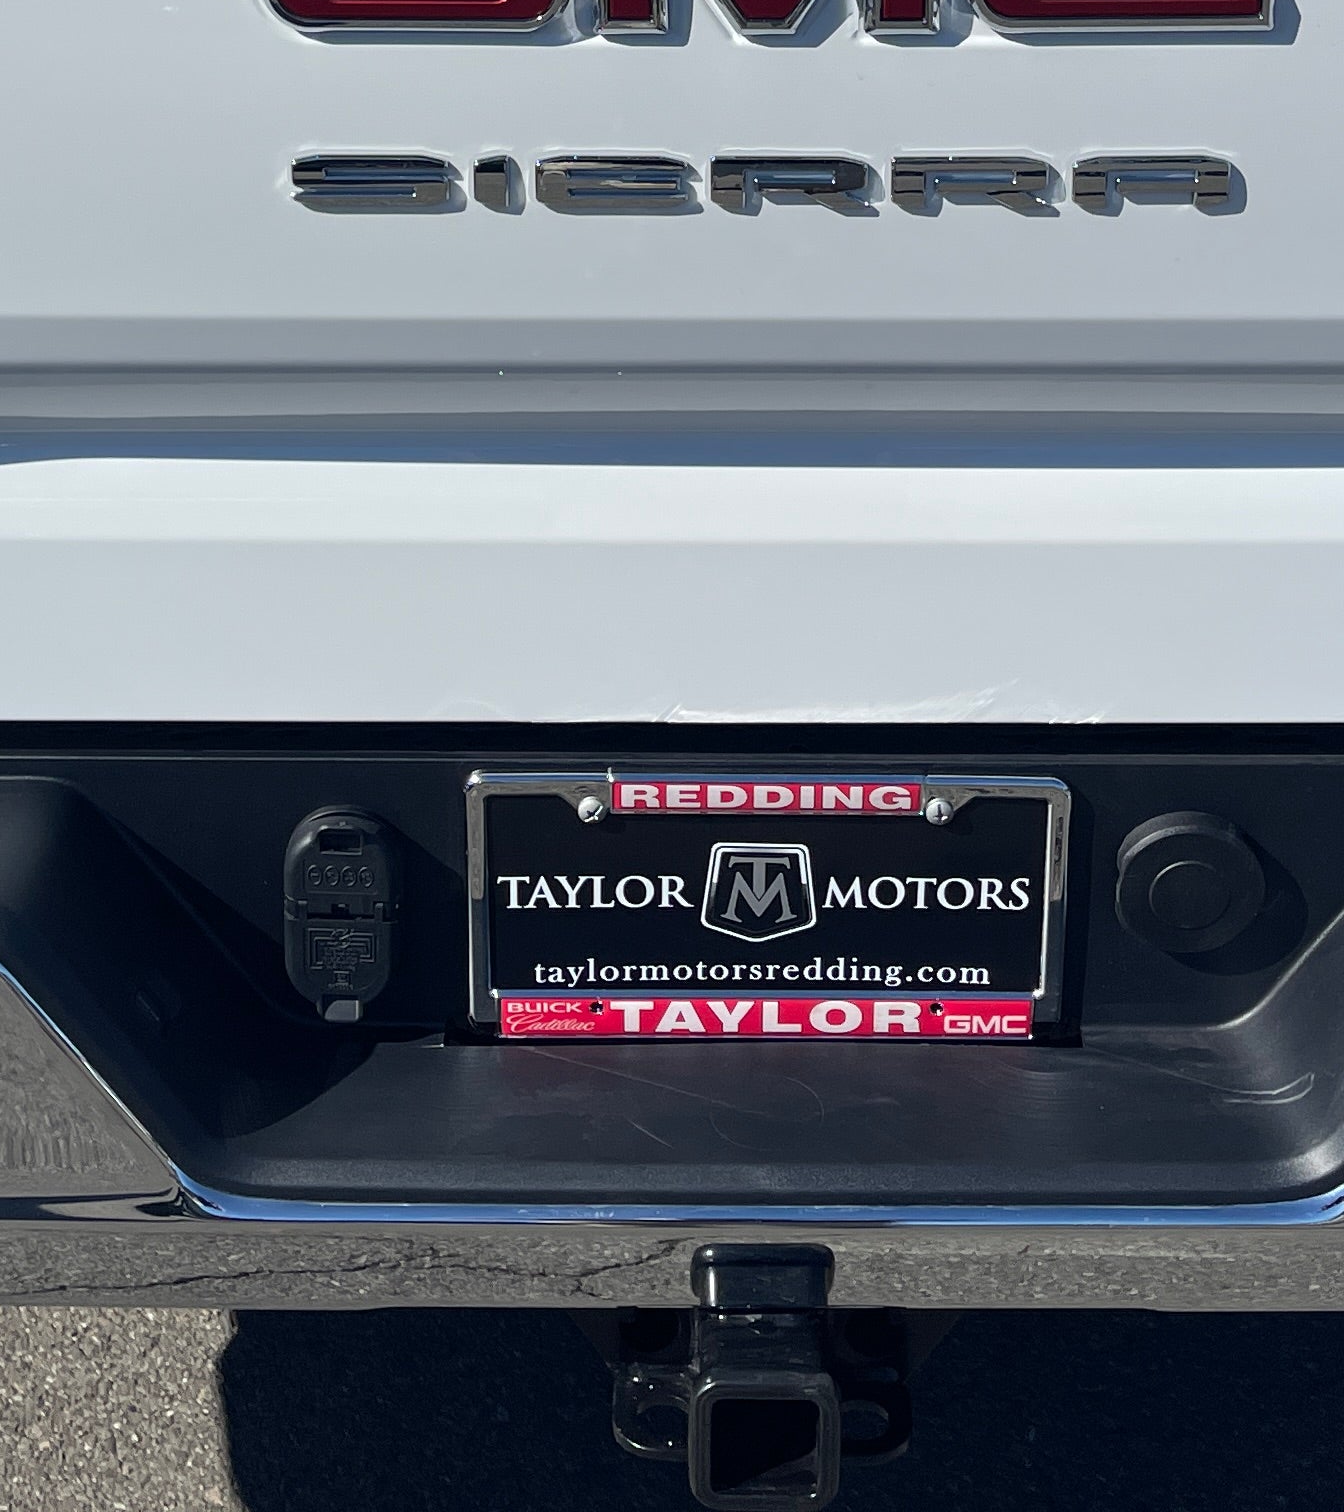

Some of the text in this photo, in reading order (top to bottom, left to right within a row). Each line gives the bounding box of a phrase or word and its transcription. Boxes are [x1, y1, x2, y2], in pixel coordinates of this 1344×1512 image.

[290, 153, 1240, 213] SIERRA
[620, 783, 912, 811] REDDING
[496, 874, 1031, 911] TAYLOR MOTORS
[533, 957, 991, 988] taylormotorsredding.com
[506, 1001, 583, 1014] BUICK
[609, 999, 922, 1034] TAYLOR
[505, 1013, 596, 1033] Cadillac
[942, 1014, 1028, 1034] GMC
